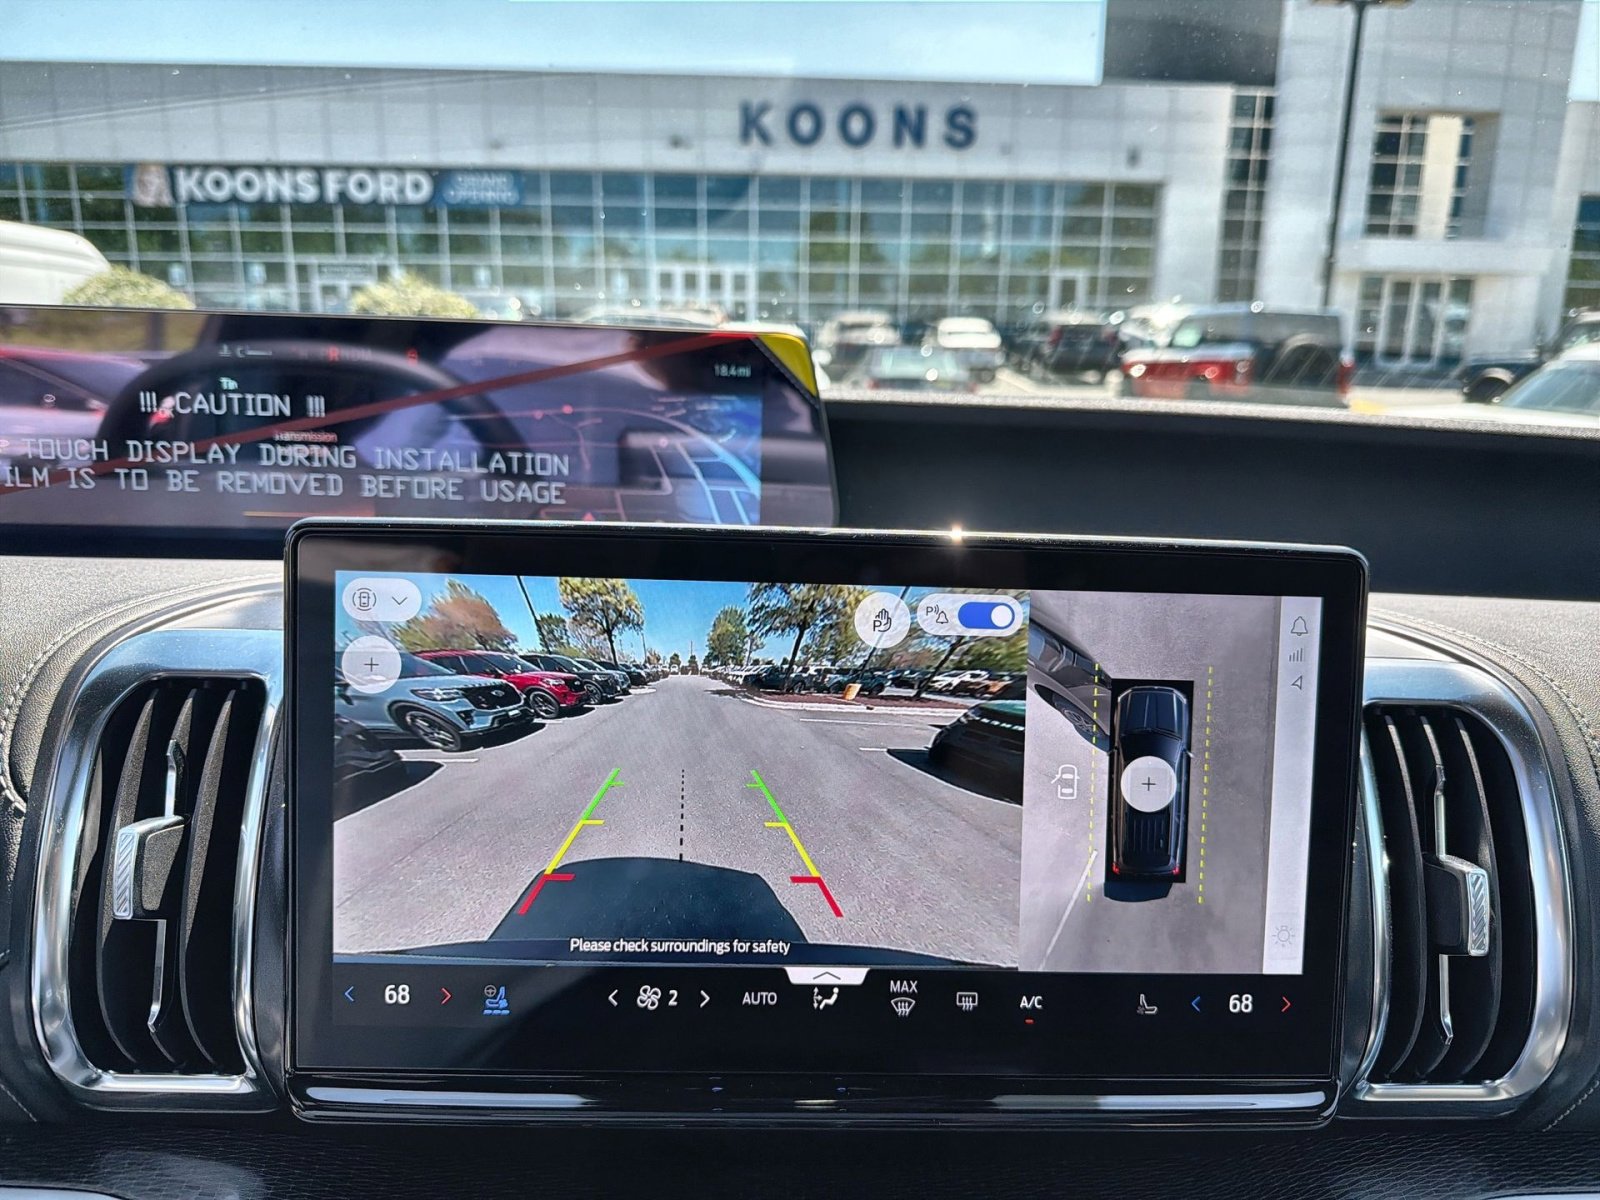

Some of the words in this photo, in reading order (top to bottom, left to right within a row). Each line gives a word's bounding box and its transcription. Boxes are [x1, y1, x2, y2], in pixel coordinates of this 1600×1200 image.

[739, 101, 977, 150] KOONS
[174, 166, 321, 203] KOONS
[323, 169, 434, 205] FORD
[175, 391, 291, 416] CAUTION
[21, 438, 109, 461] TOUCH
[126, 440, 241, 465] DISPLAY
[259, 442, 357, 468] DURING
[374, 447, 569, 476] INSTALLATION
[67, 468, 97, 489] IS
[115, 468, 149, 491] TO
[166, 469, 200, 492] BE
[217, 470, 344, 496] REMOVED
[359, 474, 464, 500] BEFORE
[480, 479, 566, 504] USAGE
[569, 938, 611, 952] Please
[613, 938, 649, 952] check
[650, 939, 731, 955] surroundings
[732, 939, 751, 953] for
[752, 939, 791, 955] safety
[384, 984, 410, 1005] 68
[890, 980, 918, 993] MAX
[668, 990, 678, 1006] 2
[742, 992, 778, 1006] AUTO
[1020, 995, 1043, 1009] A/C
[1228, 993, 1253, 1013] 68
